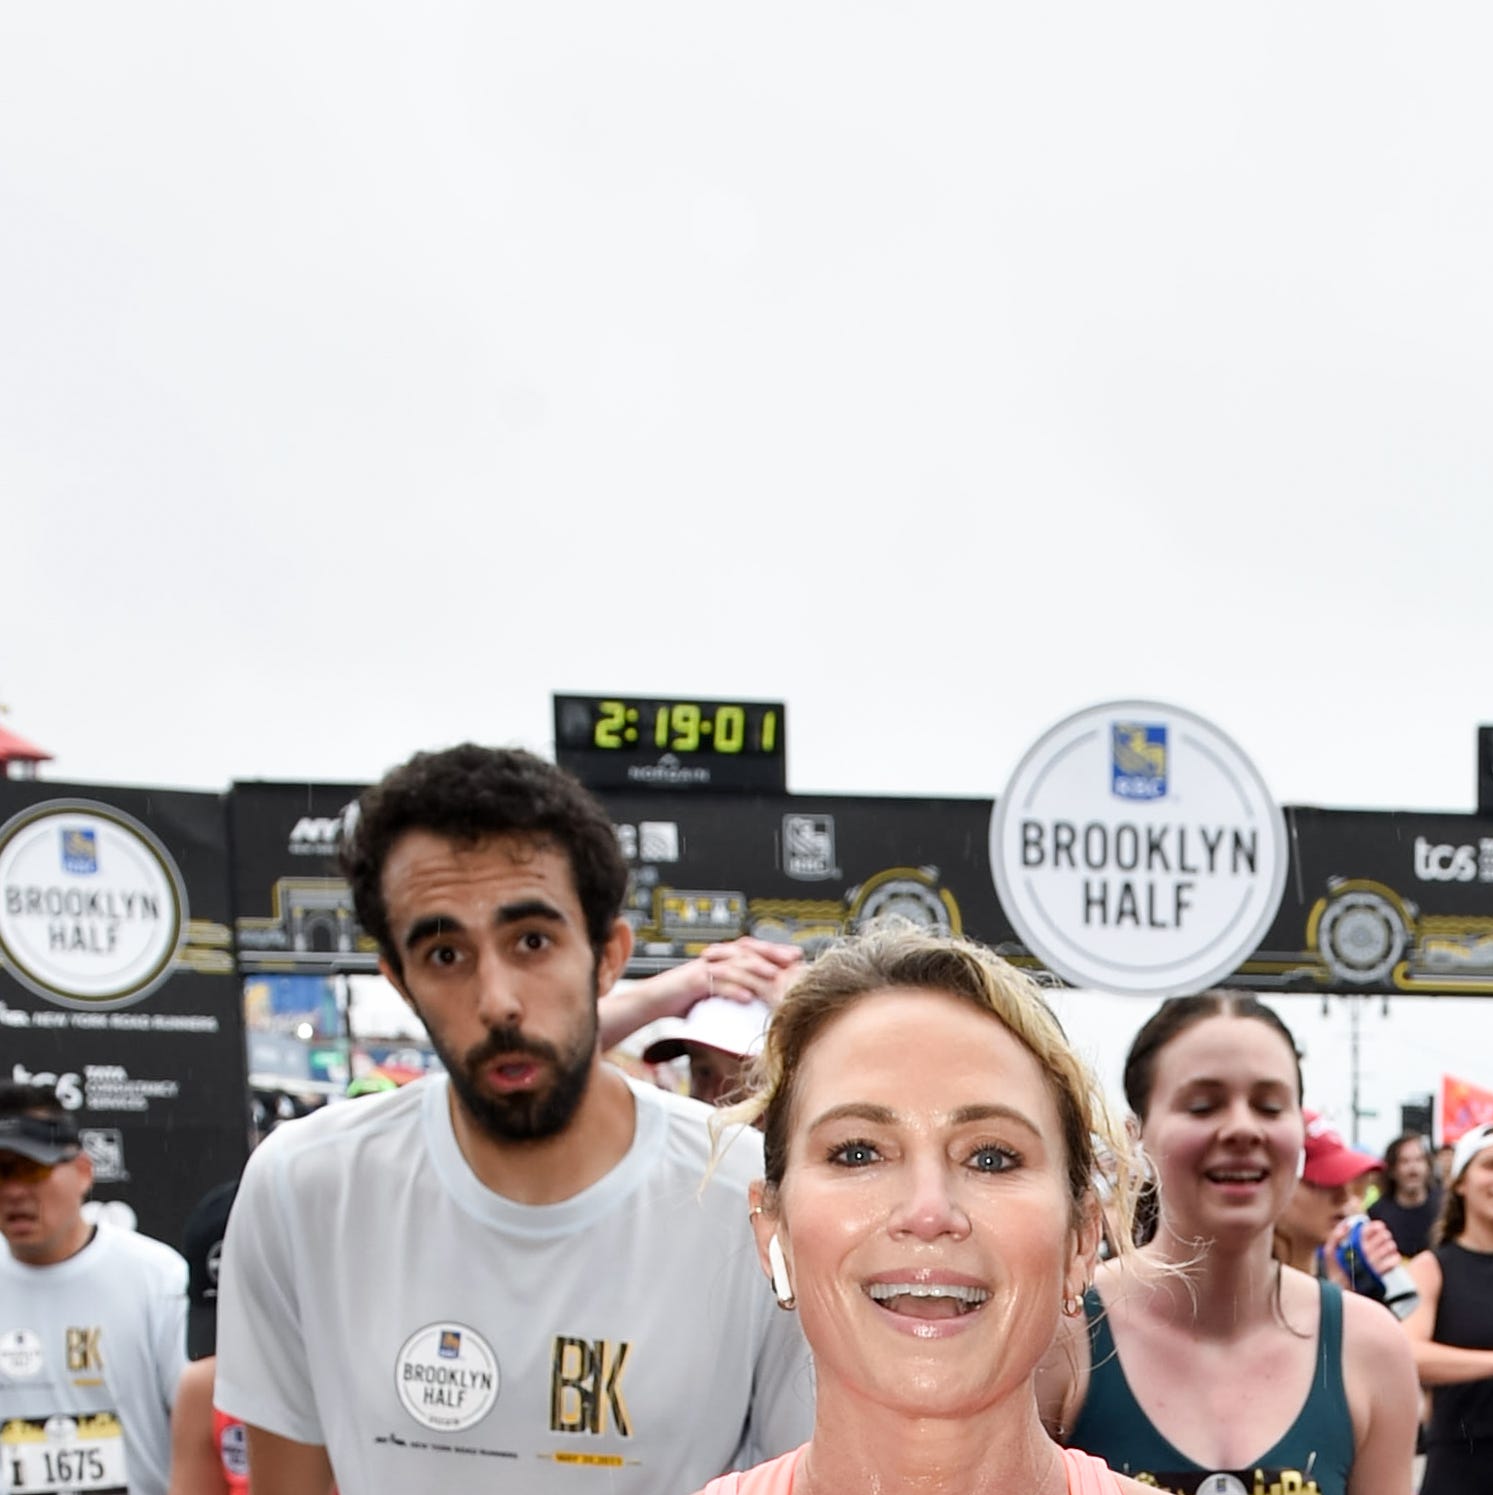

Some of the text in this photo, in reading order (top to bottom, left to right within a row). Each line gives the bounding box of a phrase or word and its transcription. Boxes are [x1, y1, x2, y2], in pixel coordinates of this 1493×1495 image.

[1022, 821, 1256, 874] BROOKLYN
[1414, 836, 1477, 881] tcs
[5, 885, 159, 920] BROOKLYN
[1084, 880, 1194, 928] HALF
[47, 919, 121, 953] HALF
[66, 1326, 104, 1371] BK
[404, 1362, 493, 1391] BROOKLYN
[423, 1386, 467, 1407] HALF
[550, 1336, 633, 1436] BK
[44, 1449, 104, 1483] 1675
